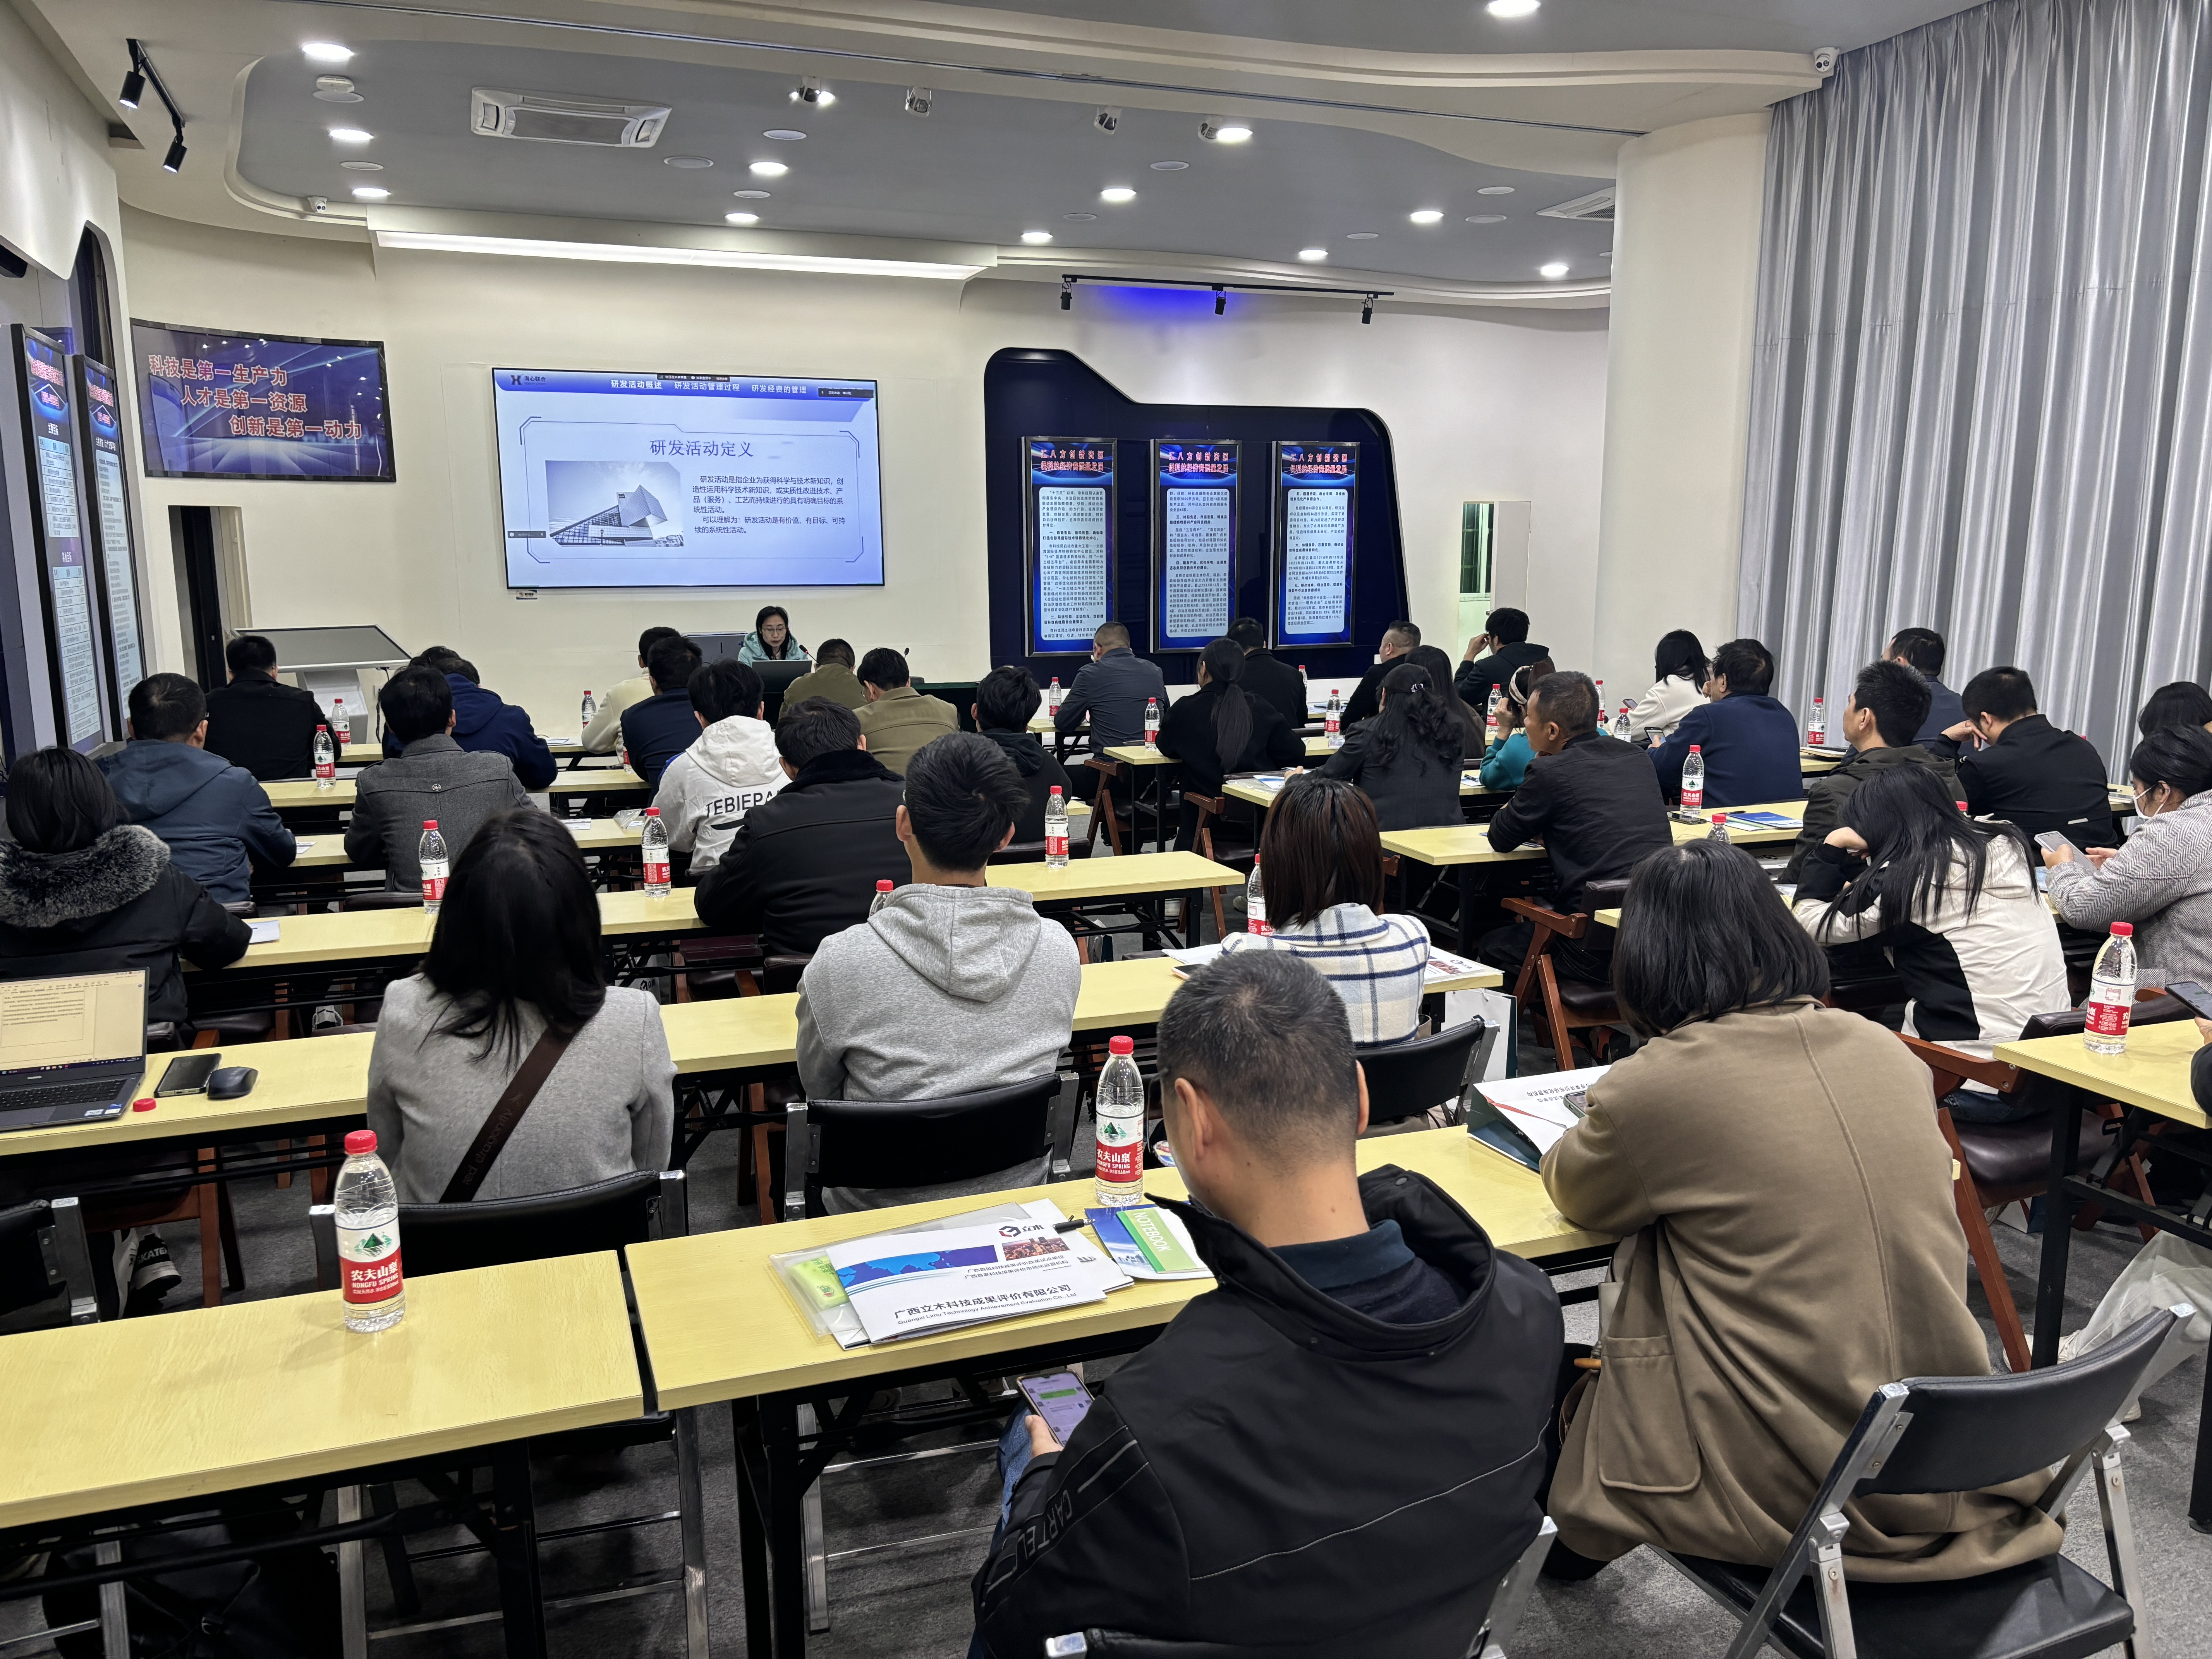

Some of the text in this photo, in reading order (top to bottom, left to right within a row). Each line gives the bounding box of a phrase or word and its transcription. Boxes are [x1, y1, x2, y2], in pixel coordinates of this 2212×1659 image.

[148, 355, 287, 386] 科技是第一生产力
[611, 380, 663, 389] 研发活动概述
[674, 381, 740, 392] 研发活动管理过程
[751, 384, 807, 394] 研发经费的管理
[180, 385, 308, 413] 人才是第一资源
[228, 415, 362, 440] 创新是第一动力
[649, 440, 754, 458] 研发活动定义
[1097, 1149, 1130, 1163] 农夫山泉
[1132, 1212, 1172, 1252] NOTEBOOK
[350, 1261, 398, 1281] 农夫山泉
[352, 1273, 398, 1288] NONGFU SPRING
[894, 1284, 1072, 1319] 广西立木科技成果评价有限公司
[898, 1315, 925, 1325] Guangxi
[942, 1306, 979, 1316] Technology
[981, 1301, 1019, 1311] Achievement
[1020, 1297, 1052, 1305] Evaluation
